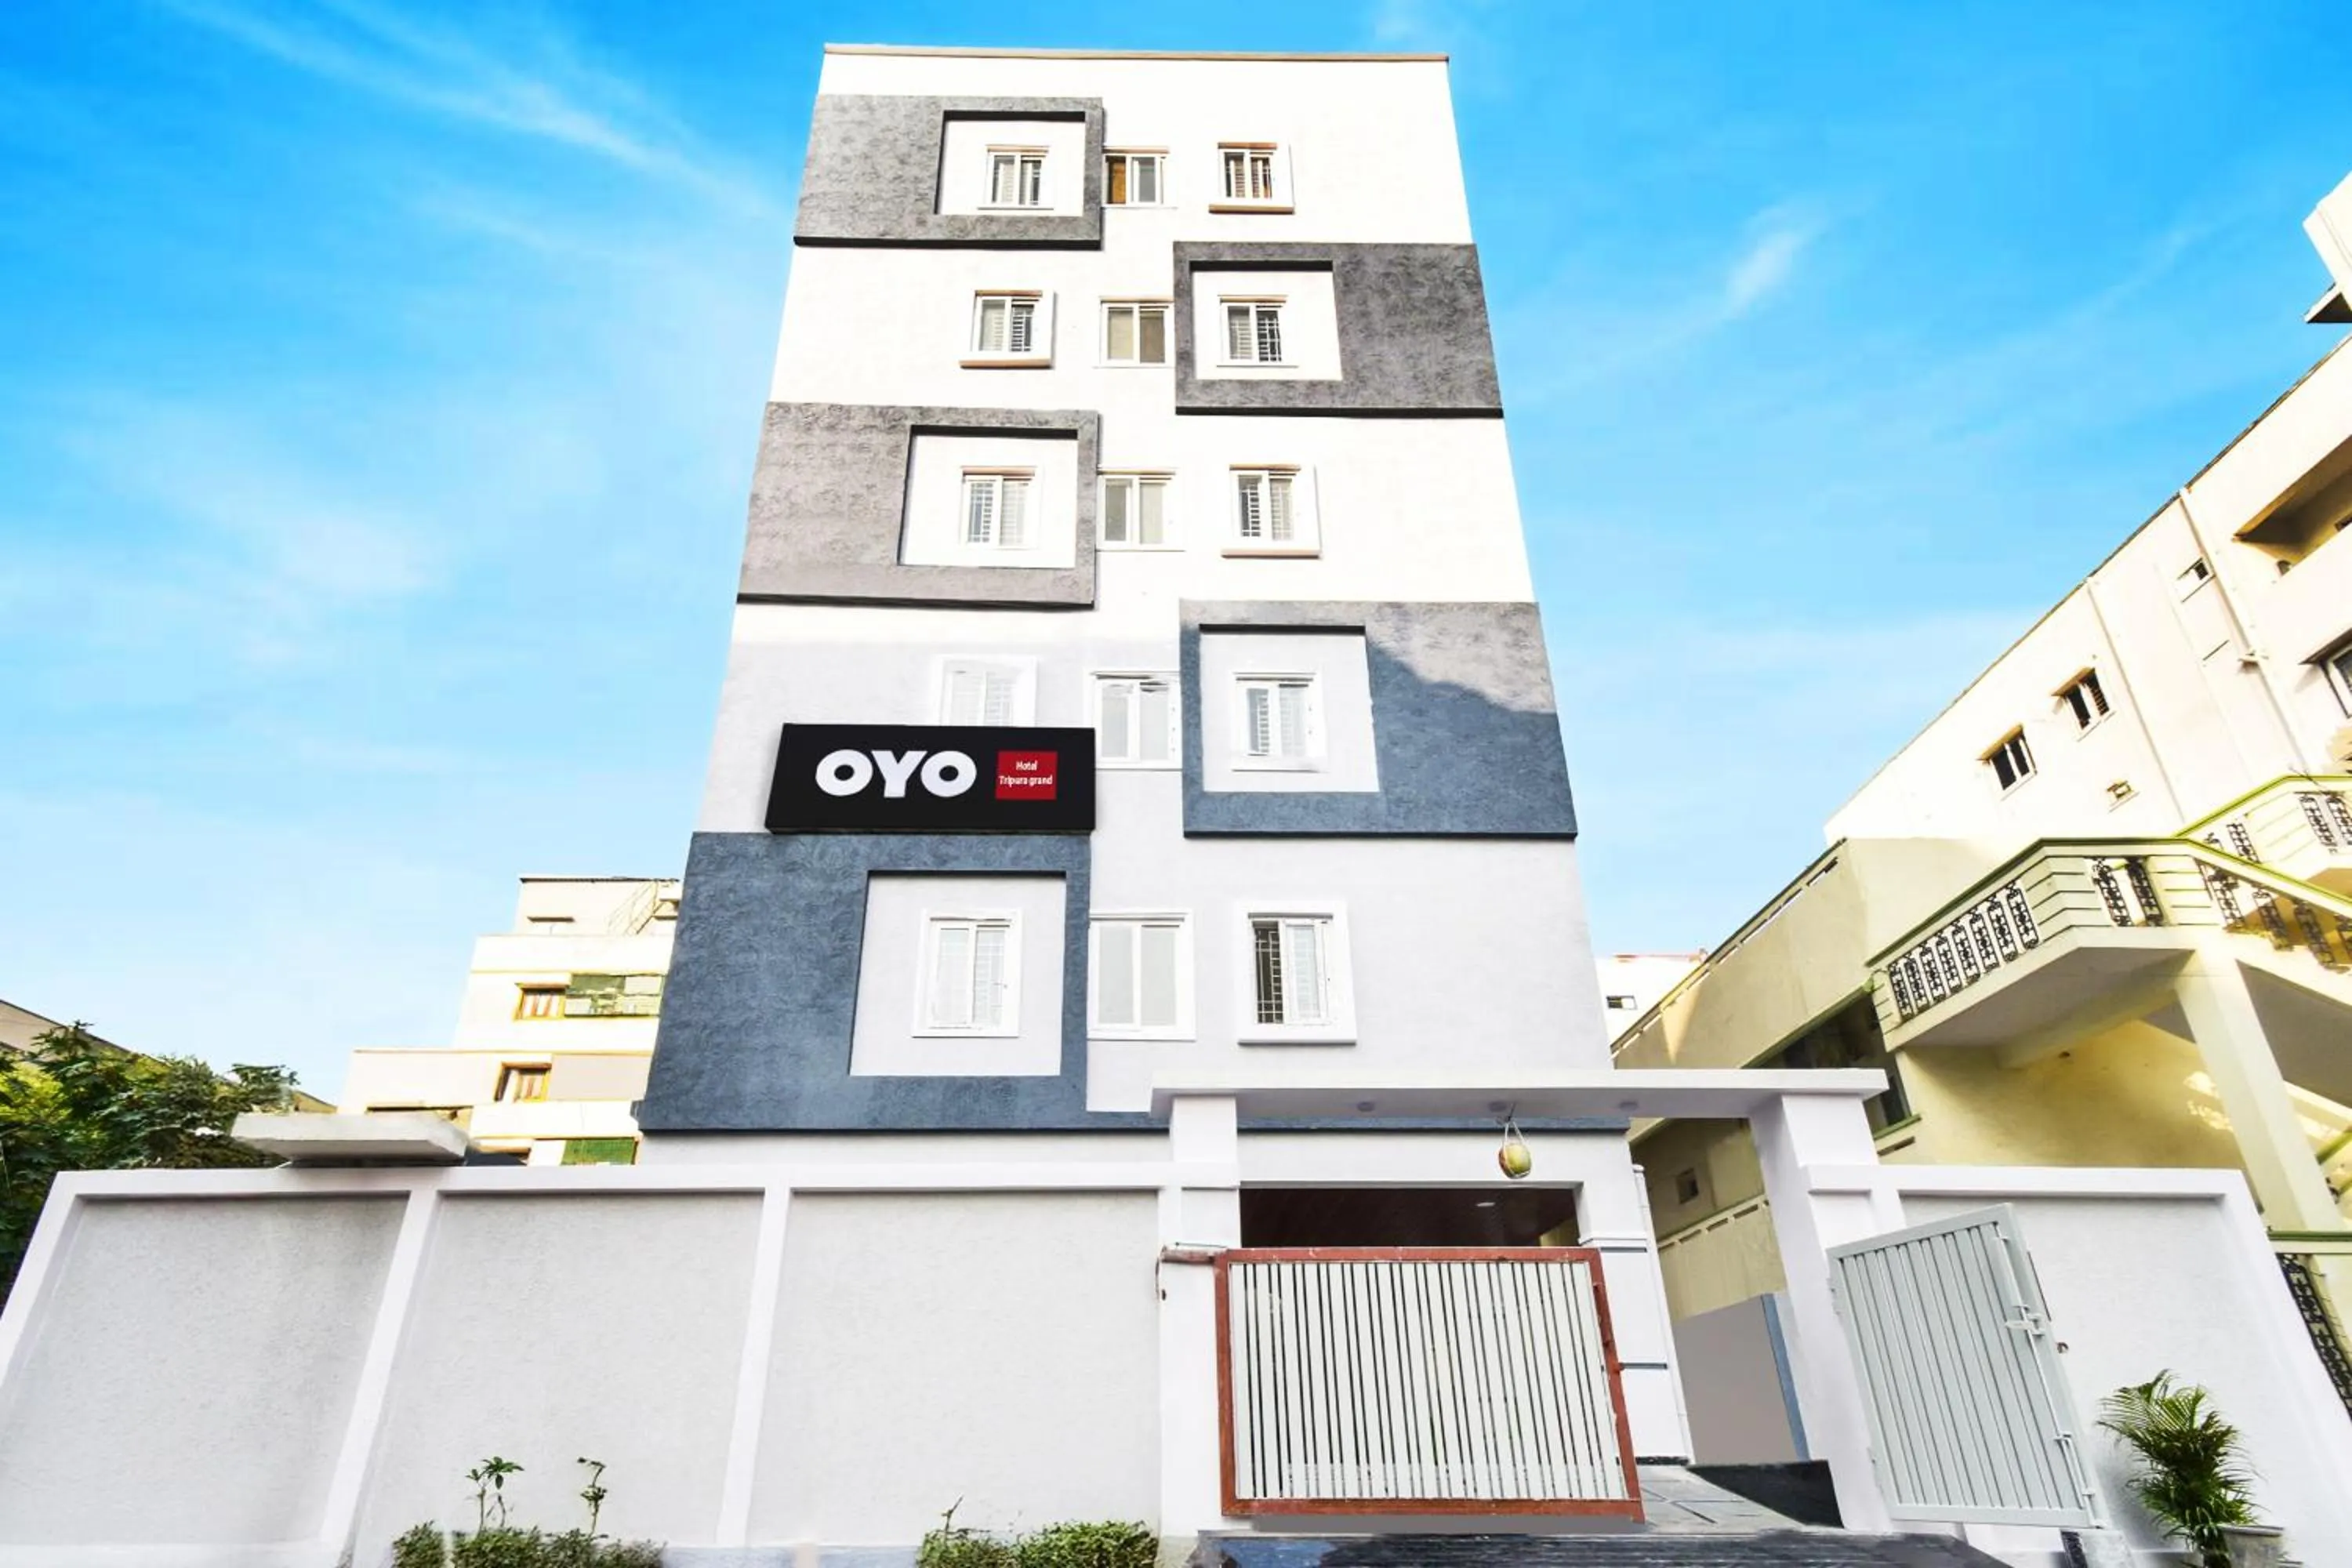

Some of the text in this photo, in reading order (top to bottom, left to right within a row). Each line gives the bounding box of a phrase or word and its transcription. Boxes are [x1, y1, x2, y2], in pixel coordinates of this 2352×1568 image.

[1016, 760, 1038, 771] Hotel
[815, 750, 977, 798] OYO
[998, 775, 1053, 788] Tripura grand
